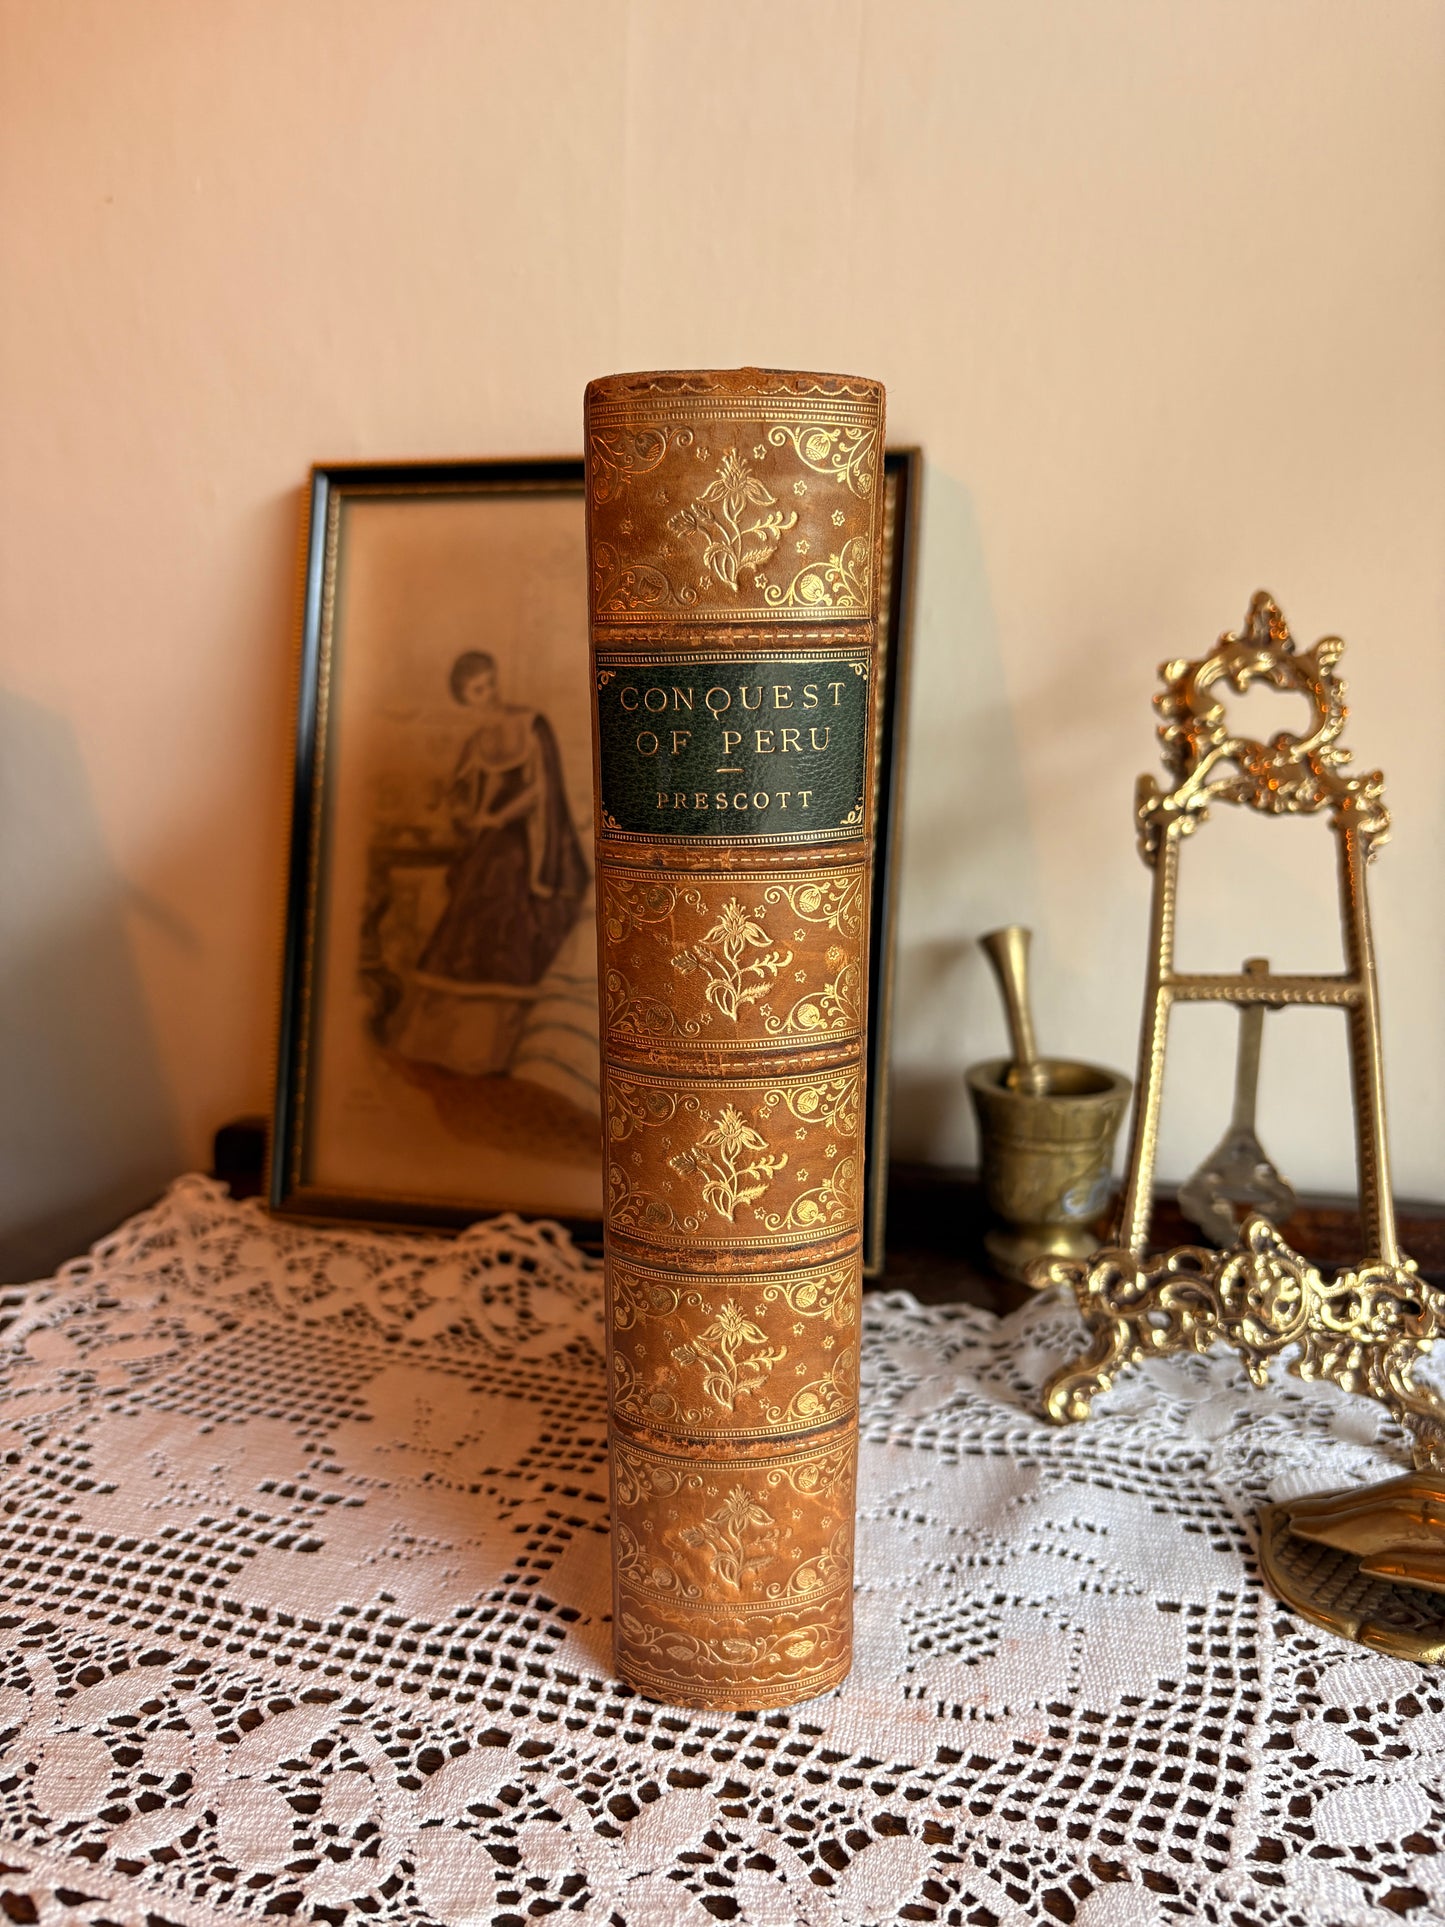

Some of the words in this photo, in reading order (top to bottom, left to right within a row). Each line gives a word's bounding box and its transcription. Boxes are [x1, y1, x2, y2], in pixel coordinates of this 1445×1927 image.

[620, 682, 846, 720] CONQUEST
[636, 730, 692, 755] OF
[722, 727, 830, 754] PERU
[656, 790, 813, 810] PRESCOTT
